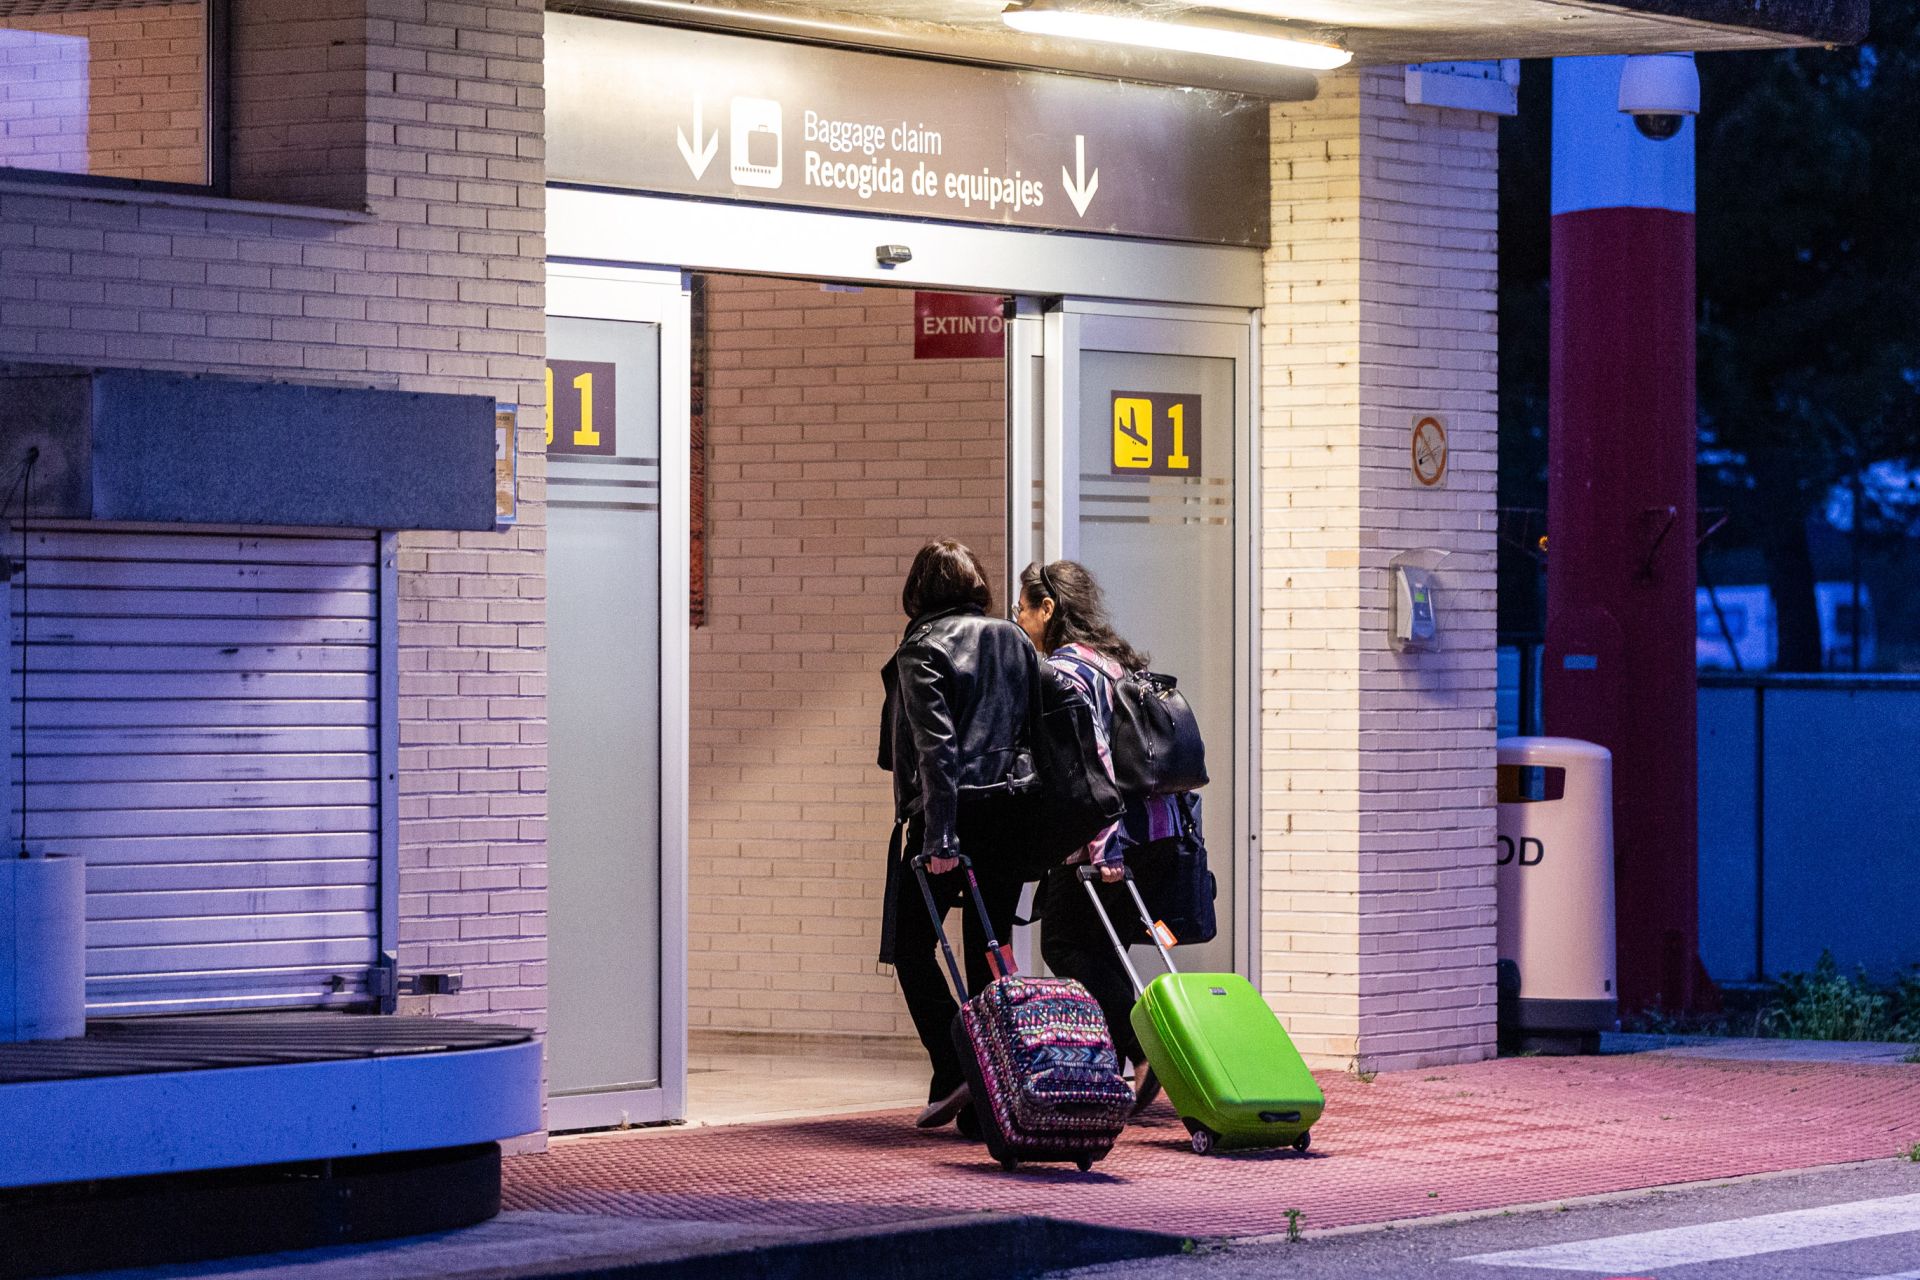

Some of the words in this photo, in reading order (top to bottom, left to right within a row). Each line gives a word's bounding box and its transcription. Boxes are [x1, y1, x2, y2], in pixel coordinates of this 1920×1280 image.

[804, 110, 885, 155] Baggage
[891, 121, 942, 155] claim
[805, 151, 904, 199] Recogida
[911, 161, 938, 197] de
[944, 167, 1044, 212] equipajes
[923, 315, 1003, 335] EXTINTO
[573, 372, 600, 446] 1
[1167, 403, 1189, 469] 1
